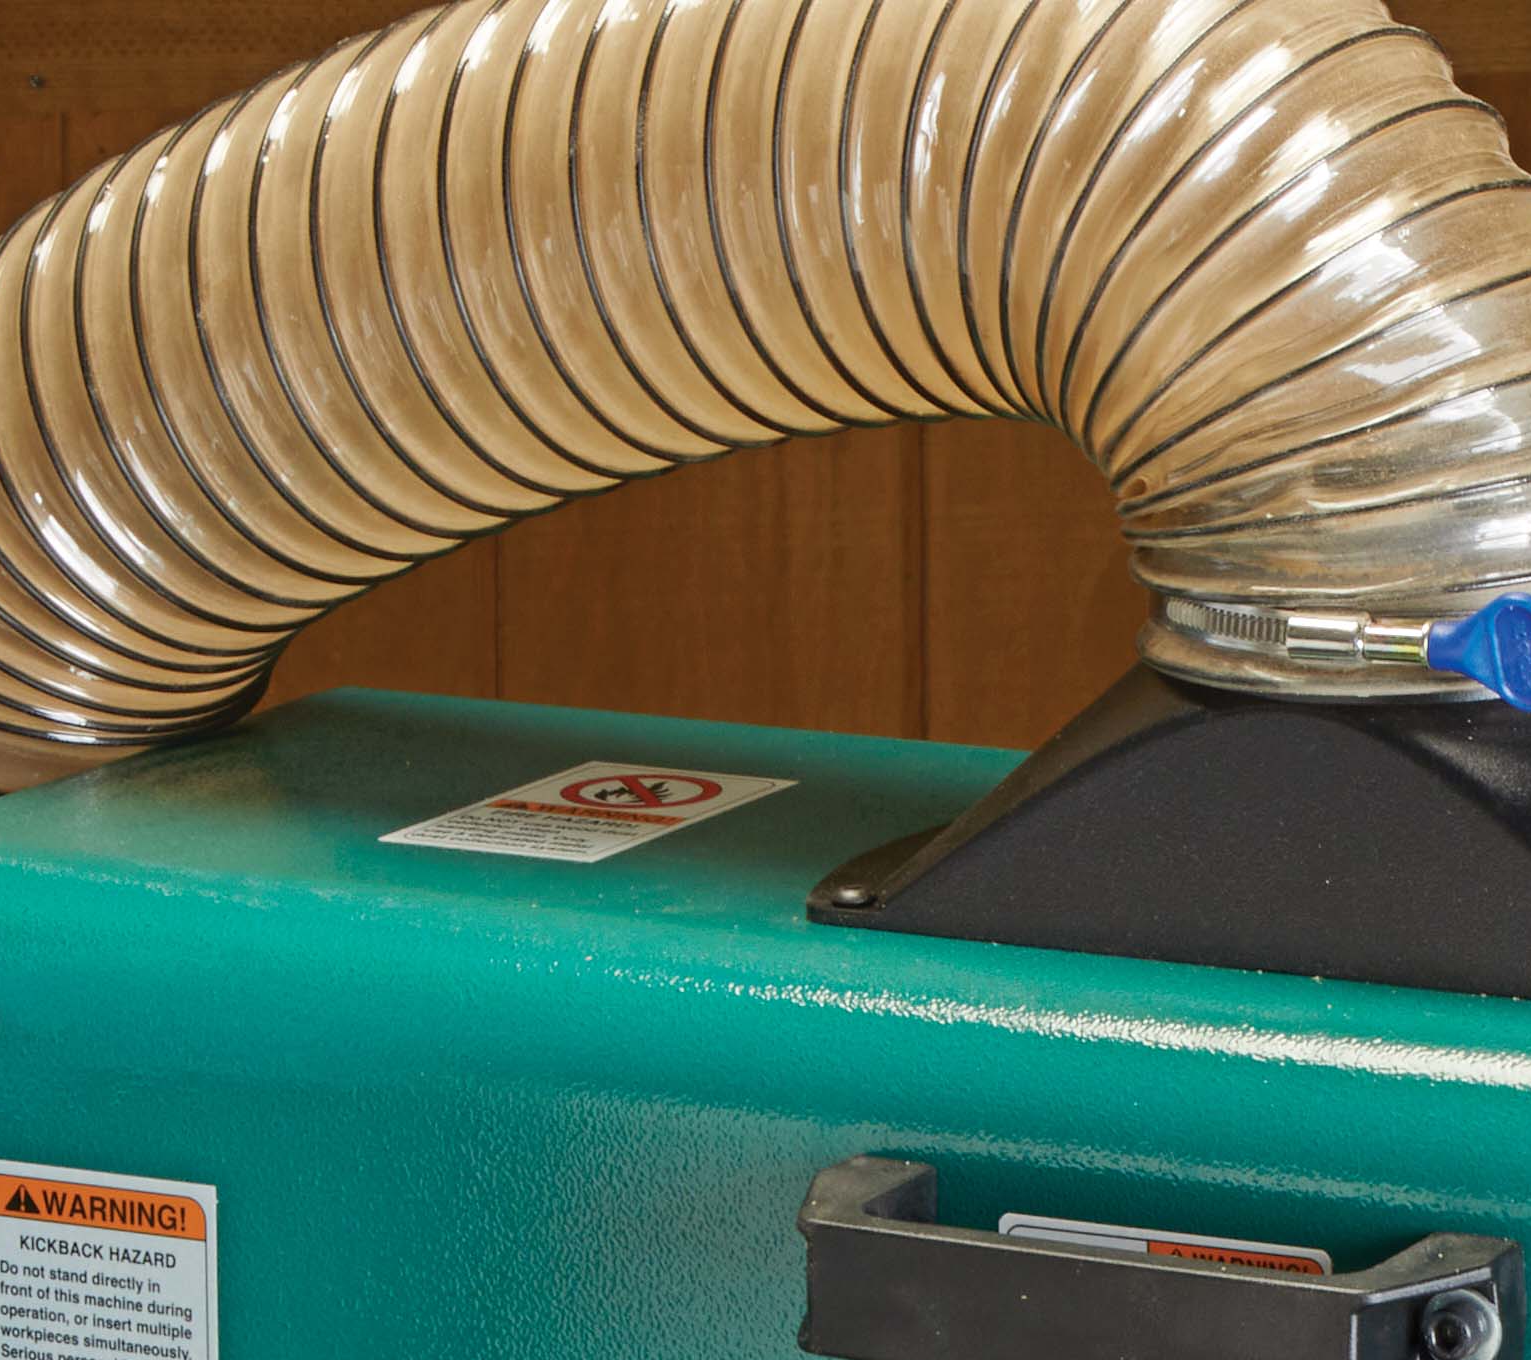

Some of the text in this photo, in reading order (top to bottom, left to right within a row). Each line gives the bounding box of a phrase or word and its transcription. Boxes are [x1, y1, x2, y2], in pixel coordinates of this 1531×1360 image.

[42, 1190, 187, 1232] WARNING!
[20, 1234, 176, 1269] KICKBACK HAZARD
[0, 1259, 161, 1295] Do not stand directly in
[0, 1280, 193, 1323] front of this machine during
[0, 1304, 193, 1341] operation, or insert multiple
[0, 1325, 79, 1346] workpieces
